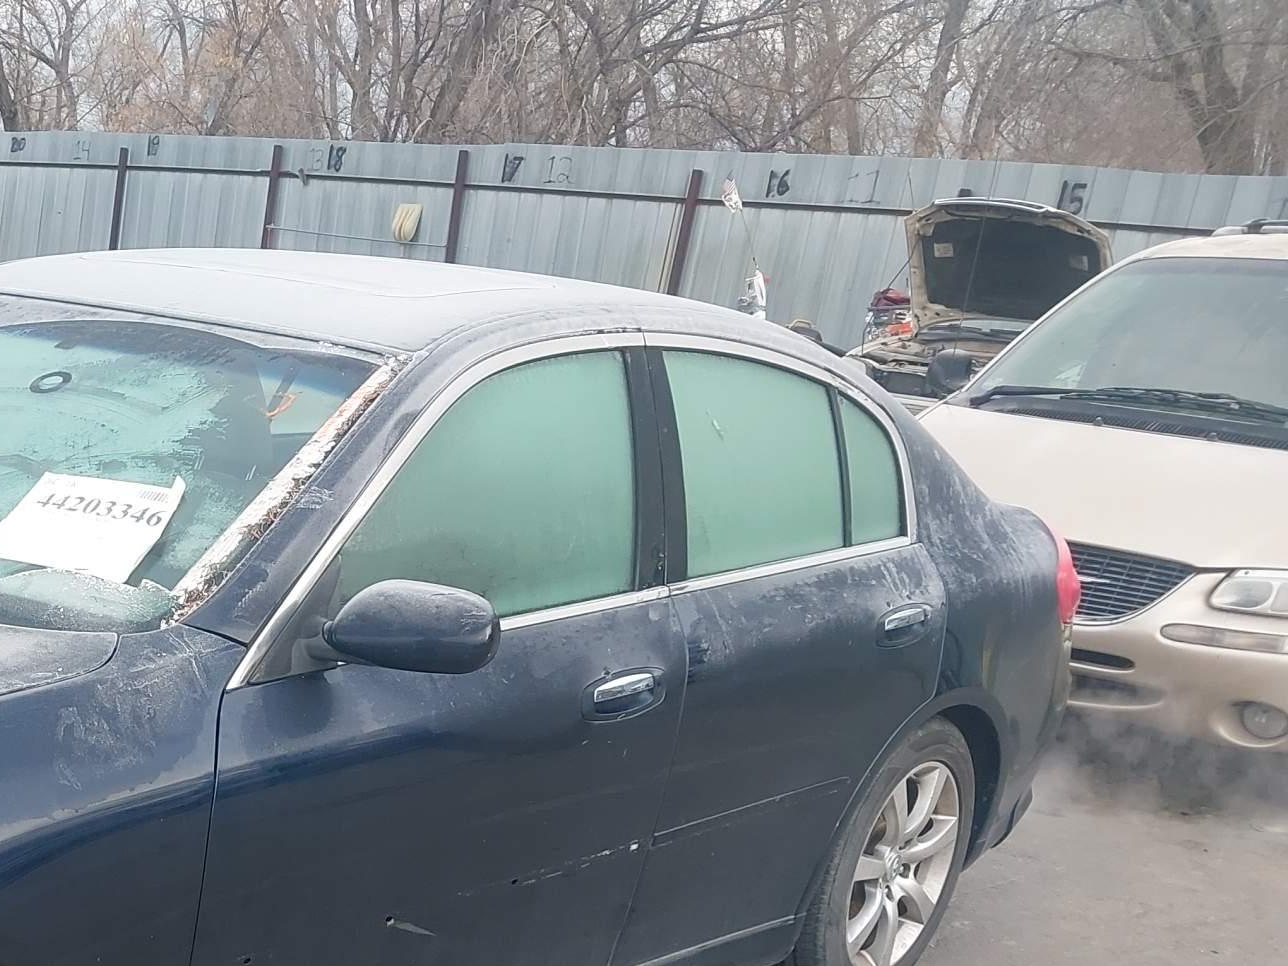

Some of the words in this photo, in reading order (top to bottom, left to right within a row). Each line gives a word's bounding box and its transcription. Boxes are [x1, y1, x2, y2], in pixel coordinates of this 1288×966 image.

[327, 144, 347, 172] 18
[543, 155, 575, 184] 12
[765, 169, 791, 198] 16
[1057, 180, 1087, 215] 15
[36, 493, 168, 527] 44203346
